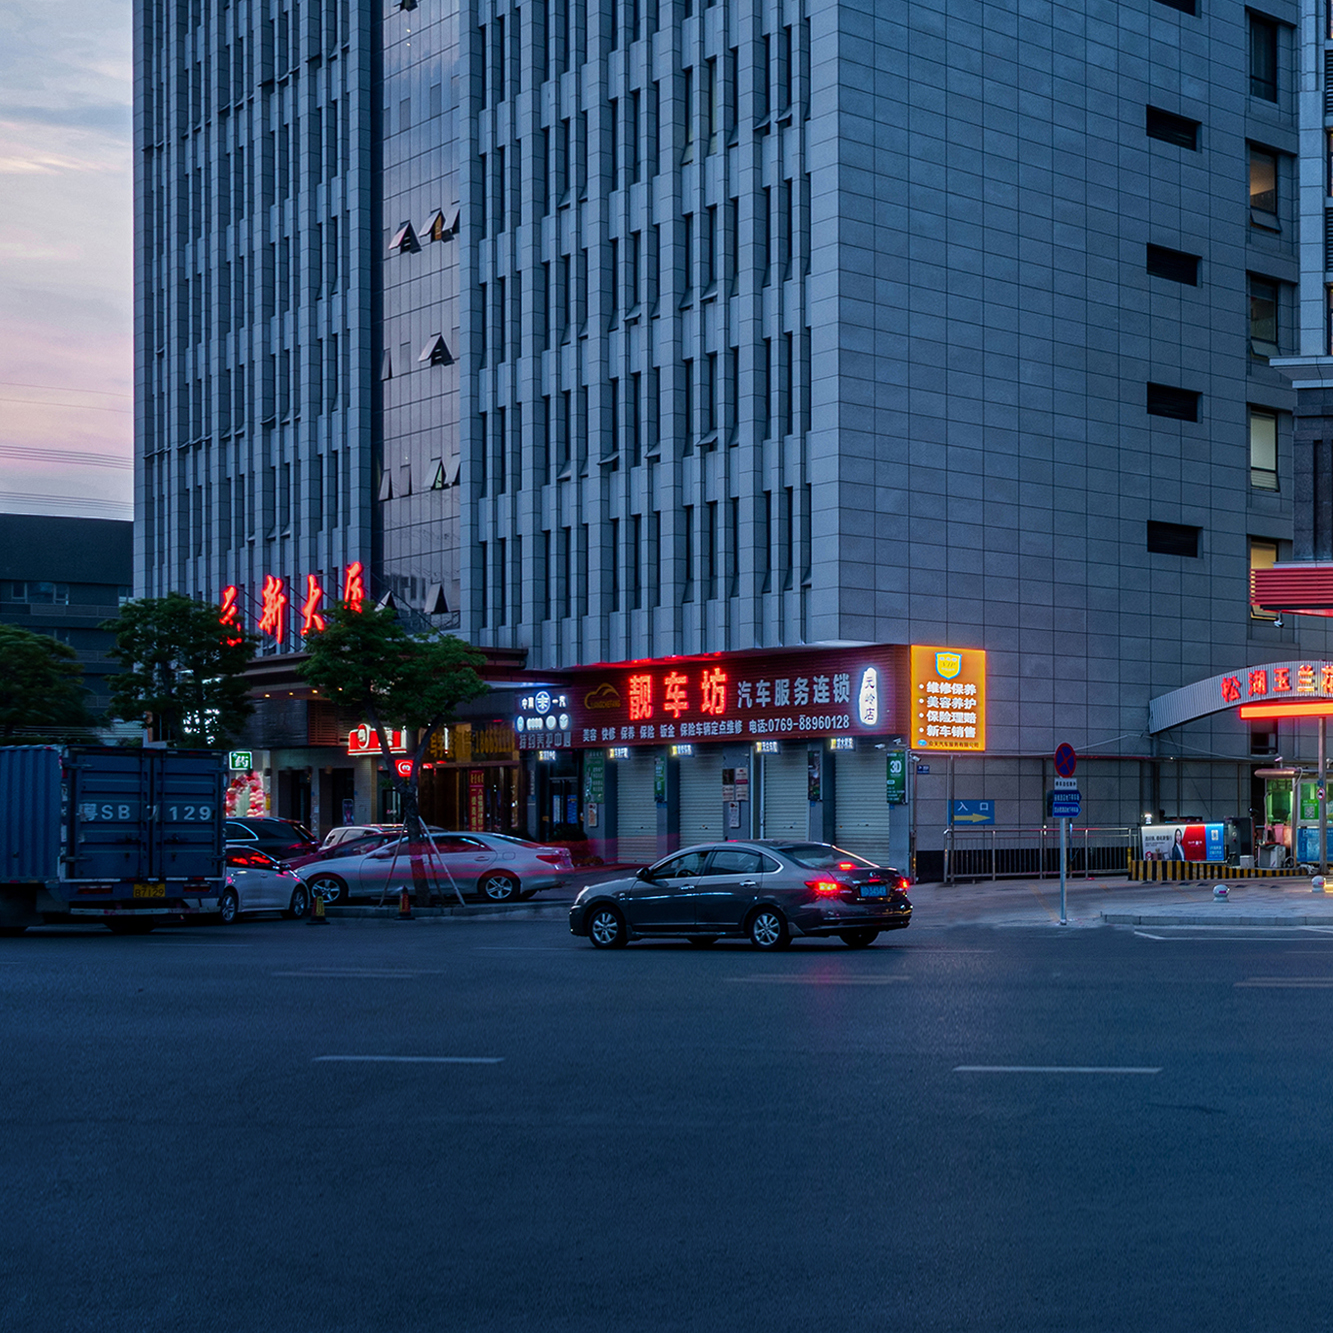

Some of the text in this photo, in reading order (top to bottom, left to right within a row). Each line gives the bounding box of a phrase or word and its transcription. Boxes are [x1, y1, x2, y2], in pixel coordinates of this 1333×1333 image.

[628, 667, 728, 721] 靓车坊
[737, 672, 850, 709] 汽车服务连锁
[926, 681, 976, 695] 维修保养
[926, 695, 977, 709] 美容养护
[926, 710, 977, 724] 保险理赔
[582, 728, 597, 742] 美容
[601, 726, 616, 741] 快修
[620, 725, 635, 740] 保养
[640, 724, 655, 739] 保险
[680, 720, 743, 737] 保险车辆定点维修
[926, 724, 976, 738] 新车销售
[889, 759, 902, 774] 3D
[957, 801, 989, 812] 入口
